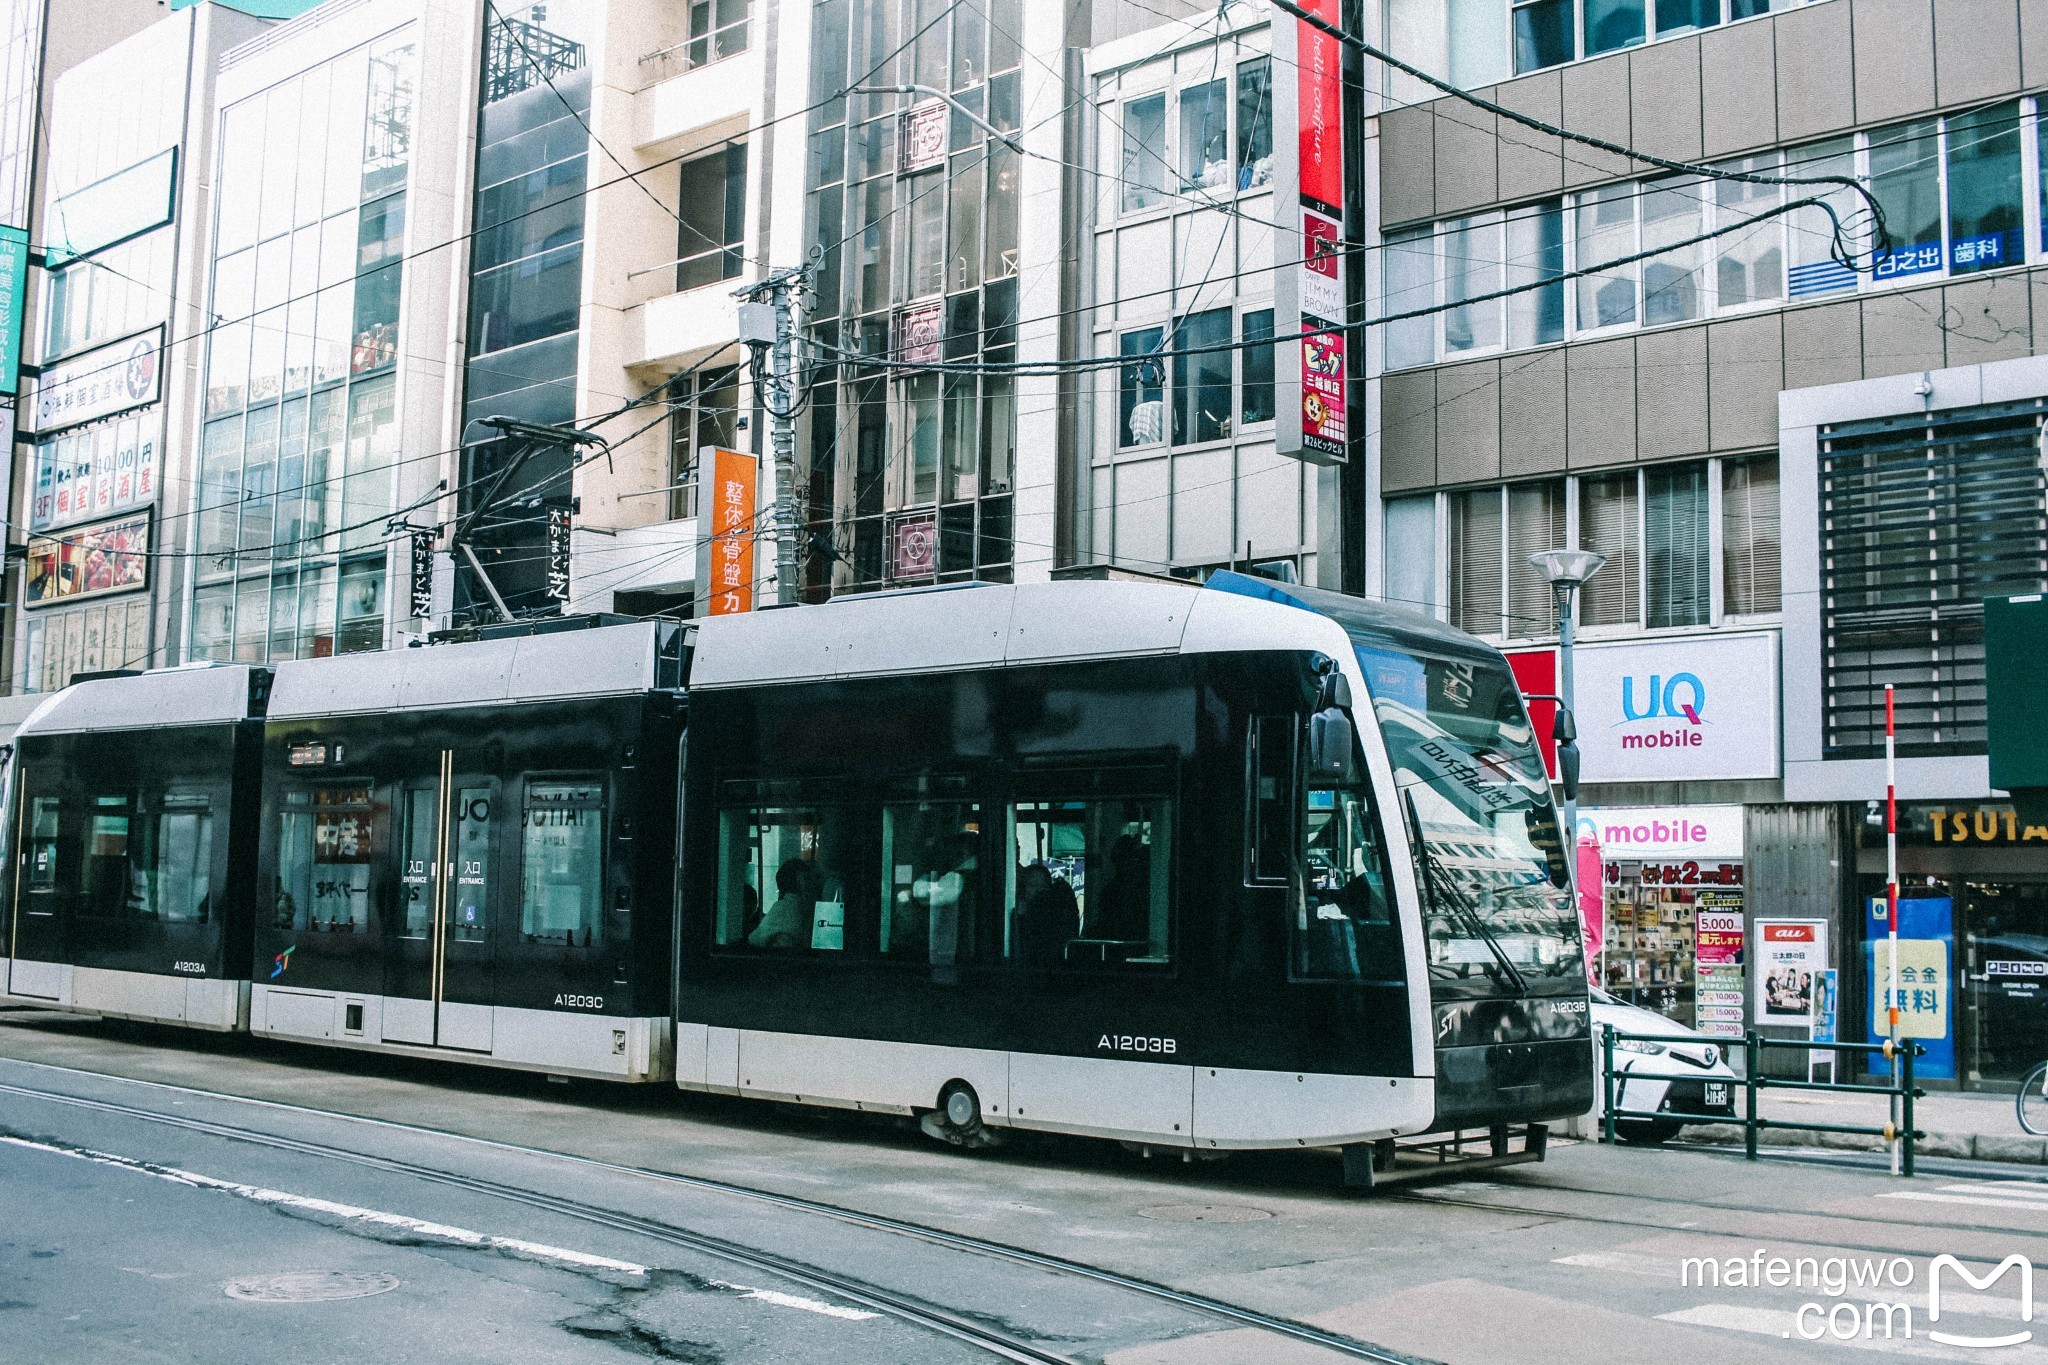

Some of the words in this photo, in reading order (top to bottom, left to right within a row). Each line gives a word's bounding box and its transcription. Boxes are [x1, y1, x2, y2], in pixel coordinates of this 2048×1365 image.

[1312, 35, 1325, 86] belle
[1312, 88, 1326, 167] coiffure
[1316, 202, 1326, 212] 2F
[1876, 247, 1939, 276] 日之出
[1954, 238, 1999, 263] 歯科
[1304, 281, 1338, 303] JIMMY
[1304, 295, 1338, 318] BROWN
[1304, 343, 1343, 378] ビッグ
[1305, 374, 1340, 396] 三越前店
[36, 495, 51, 518] 3F
[1622, 672, 1705, 725] UQ
[1622, 729, 1703, 749] mobile
[1604, 820, 1707, 843] mobile
[408, 860, 424, 873] 入口
[464, 861, 481, 875] 入口
[403, 876, 428, 884] ENTRANCE
[459, 877, 485, 885] ENTRANCE
[1701, 918, 1734, 930] 5,000
[1775, 929, 1805, 938] au
[173, 961, 206, 974] A1203A
[554, 993, 603, 1009] A1203C
[1550, 1002, 1587, 1013] A1203B
[1883, 987, 1938, 1014] 無料
[1097, 1034, 1176, 1053] A1203B
